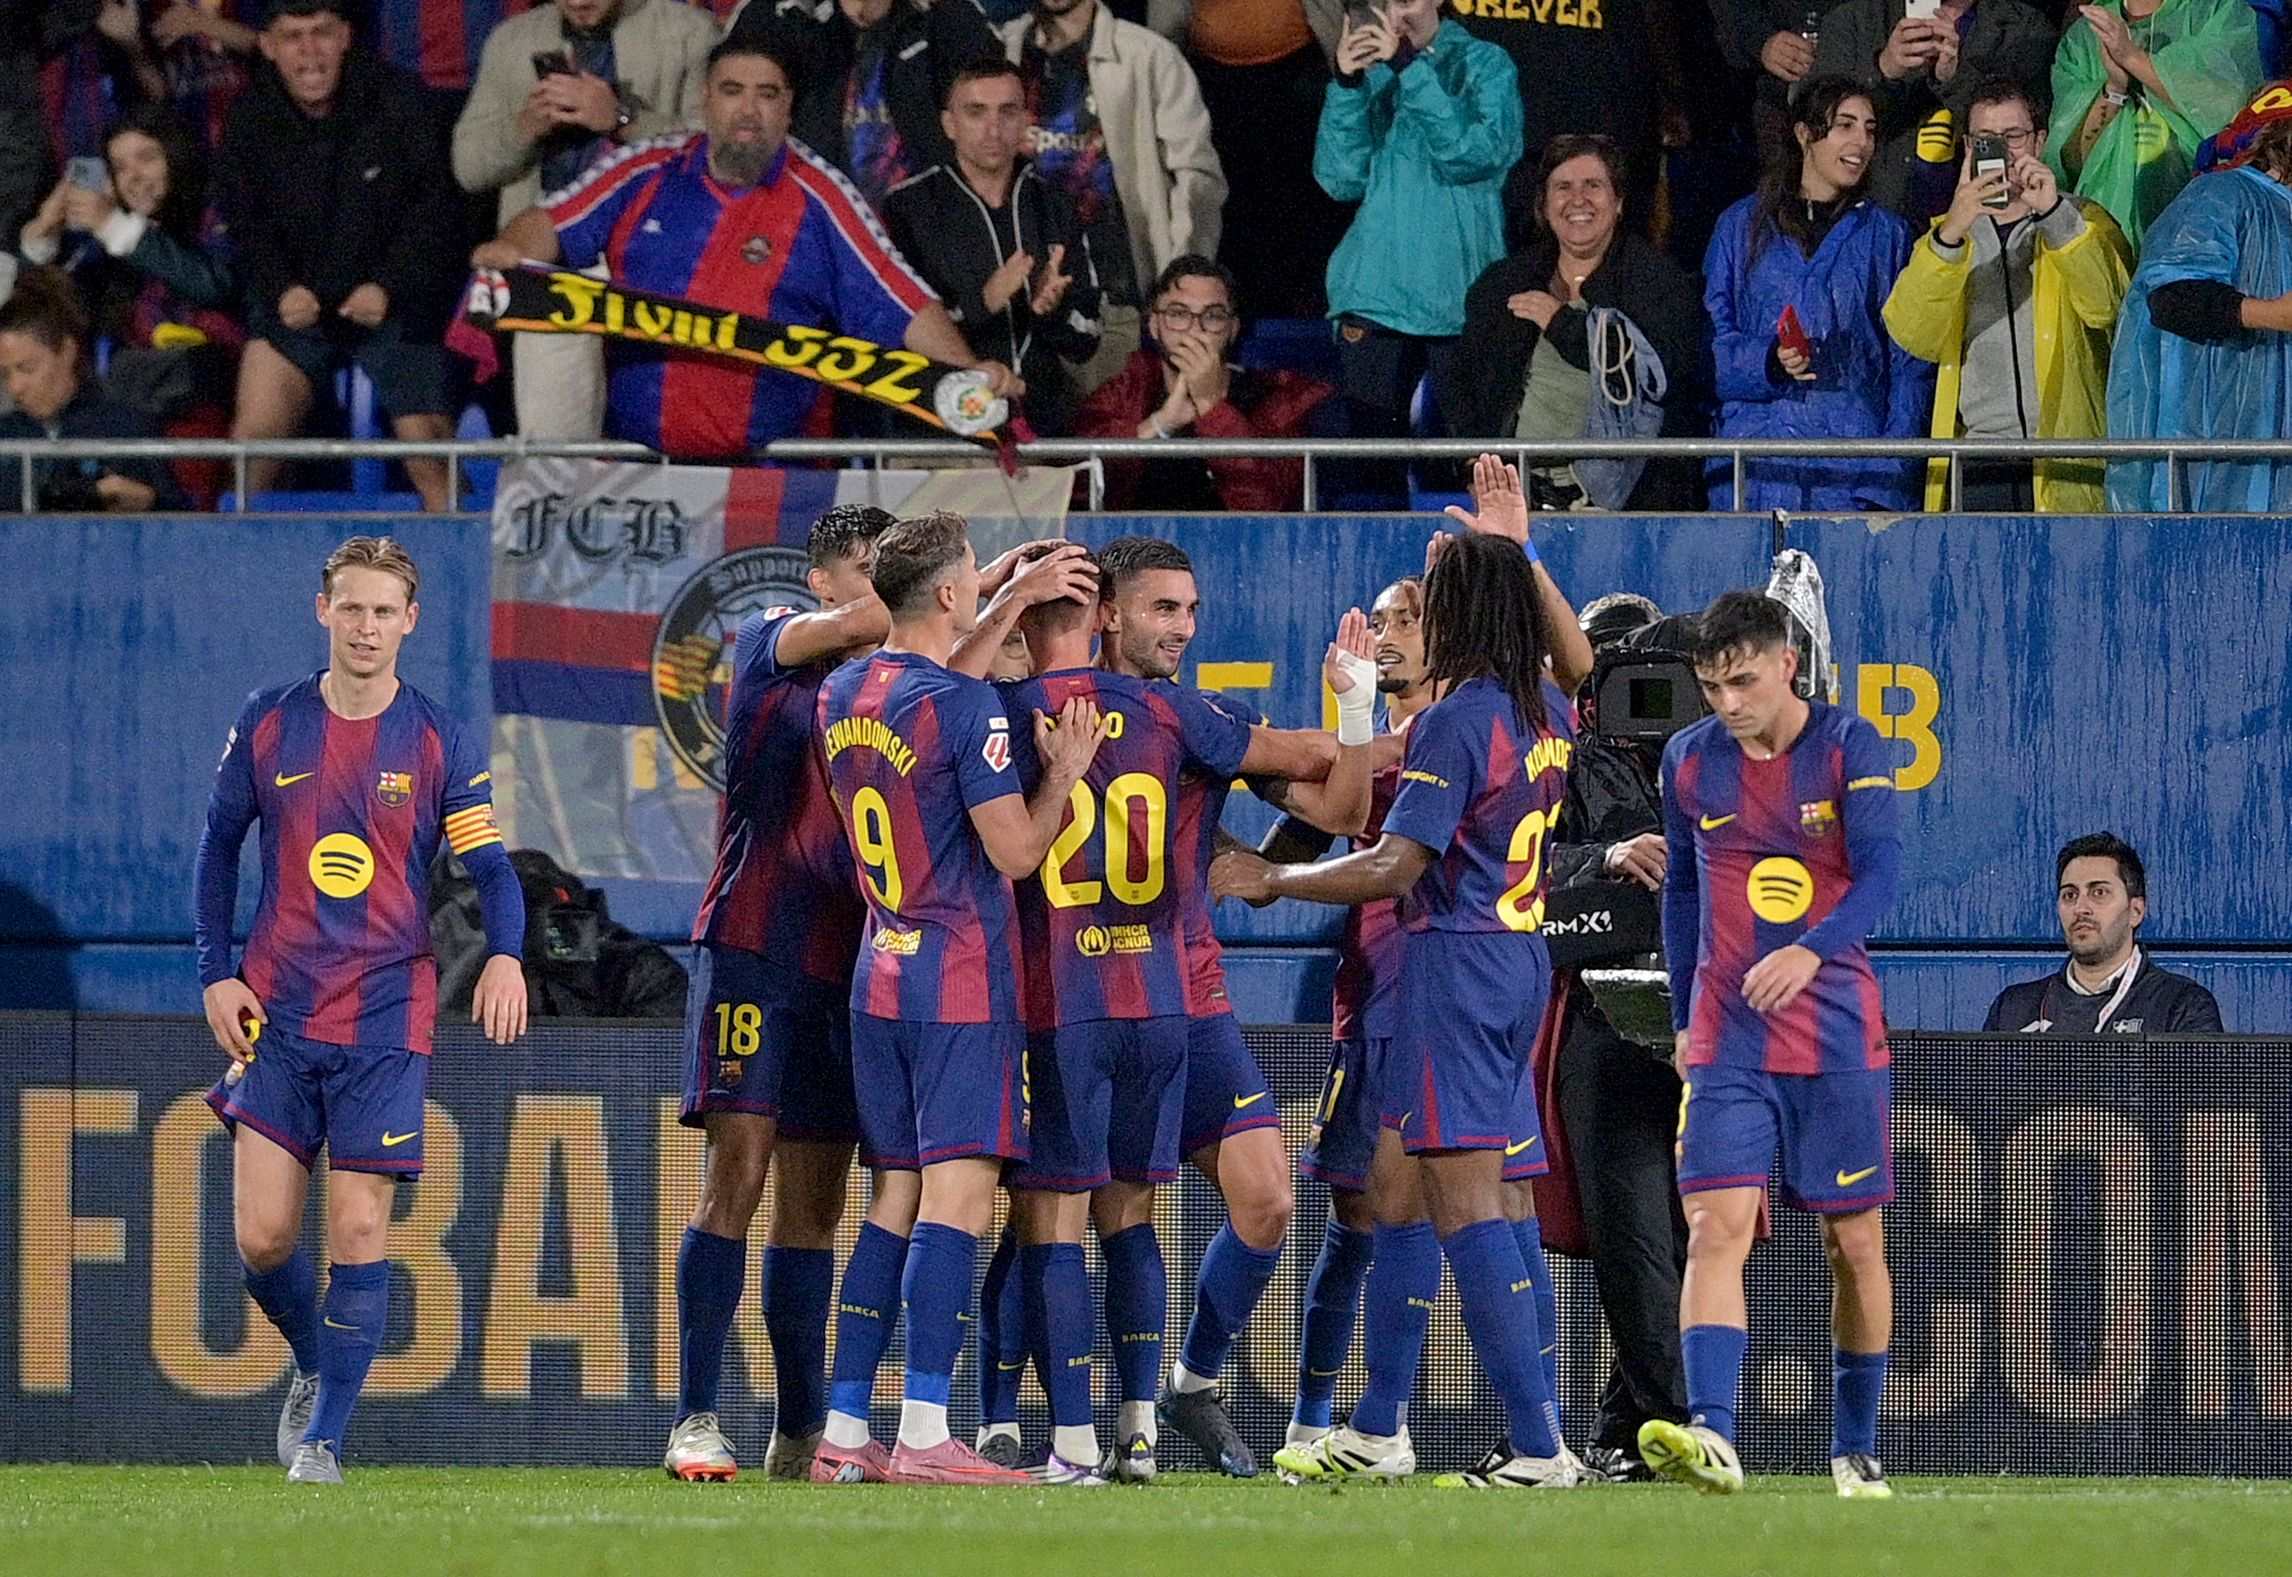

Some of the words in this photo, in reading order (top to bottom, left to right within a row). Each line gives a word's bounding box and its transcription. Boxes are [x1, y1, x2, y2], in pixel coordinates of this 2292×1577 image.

[824, 717, 917, 778] LEWANDOWSKI
[852, 786, 904, 914] 9
[1039, 772, 1167, 909] 20
[1496, 799, 1563, 933] 2
[714, 1003, 762, 1056] 18
